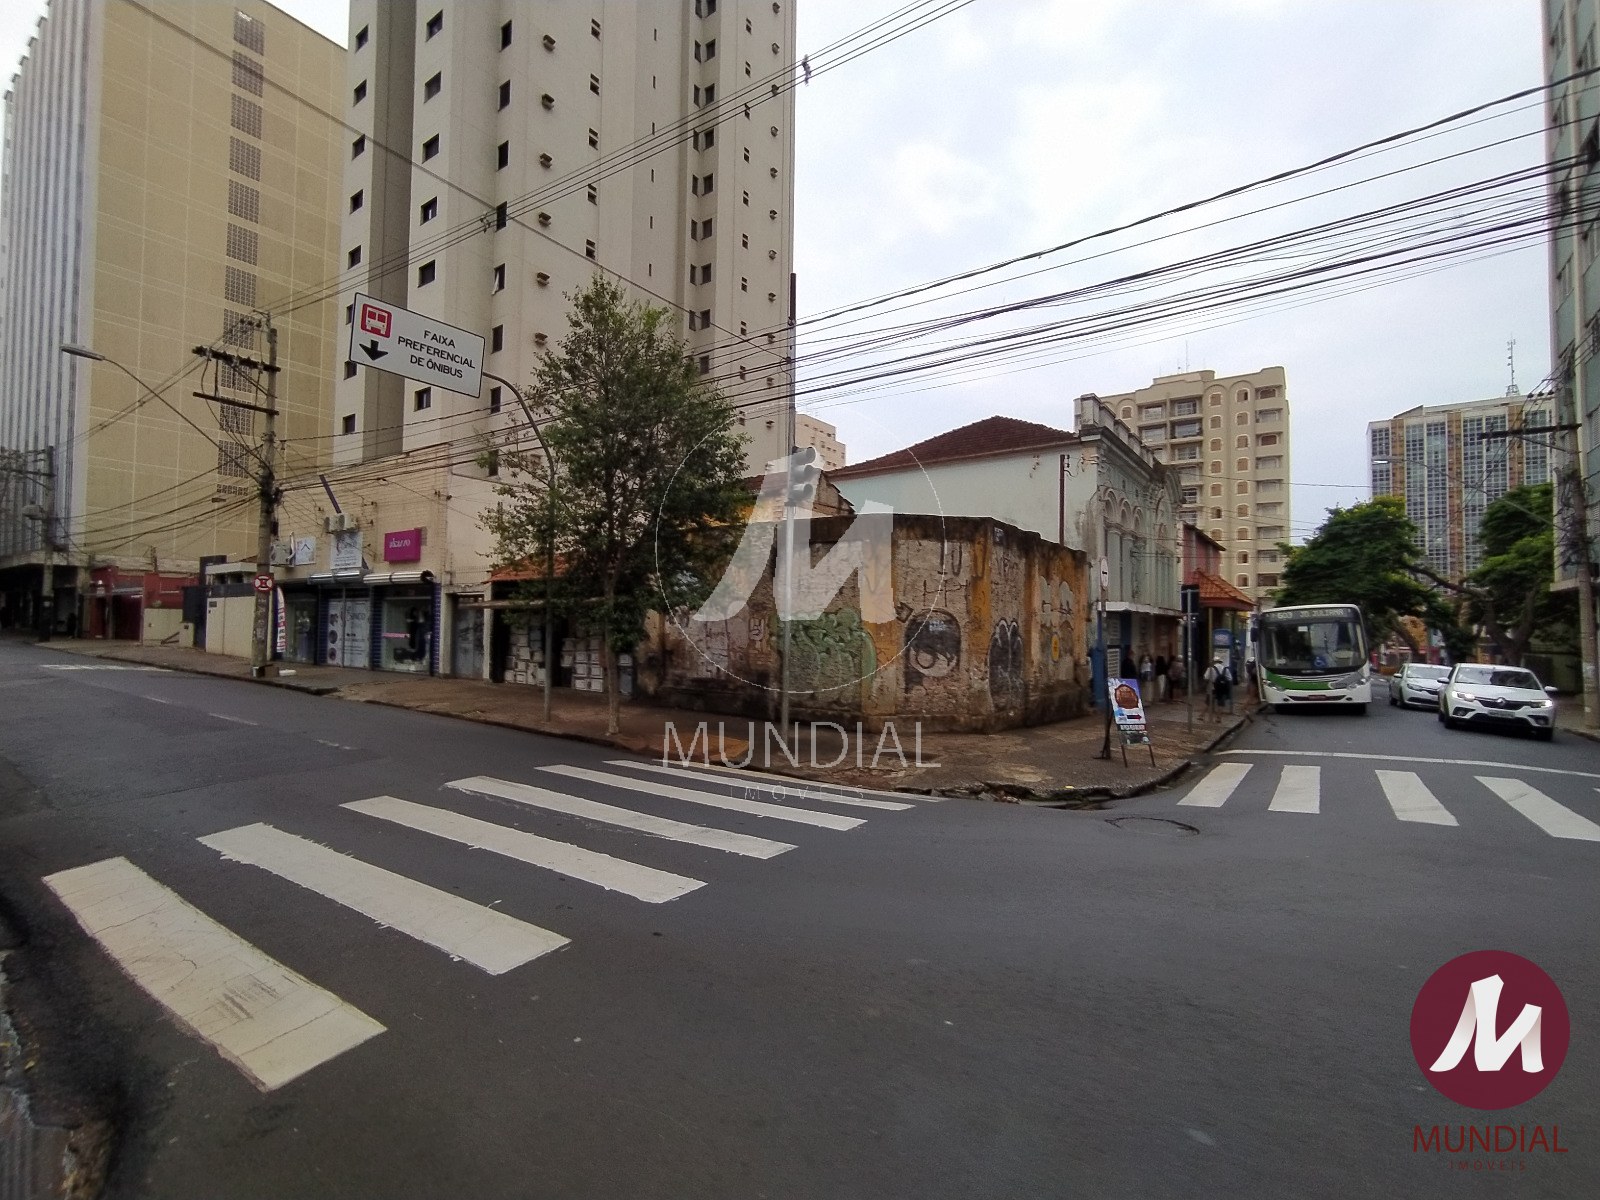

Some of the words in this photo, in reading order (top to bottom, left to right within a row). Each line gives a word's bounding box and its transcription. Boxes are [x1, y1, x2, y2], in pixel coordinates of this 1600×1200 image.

[423, 330, 456, 348] FAIXA
[397, 336, 476, 369] PREFERENCIAL
[410, 354, 424, 367] DE
[426, 359, 463, 379] ÔNIBUS
